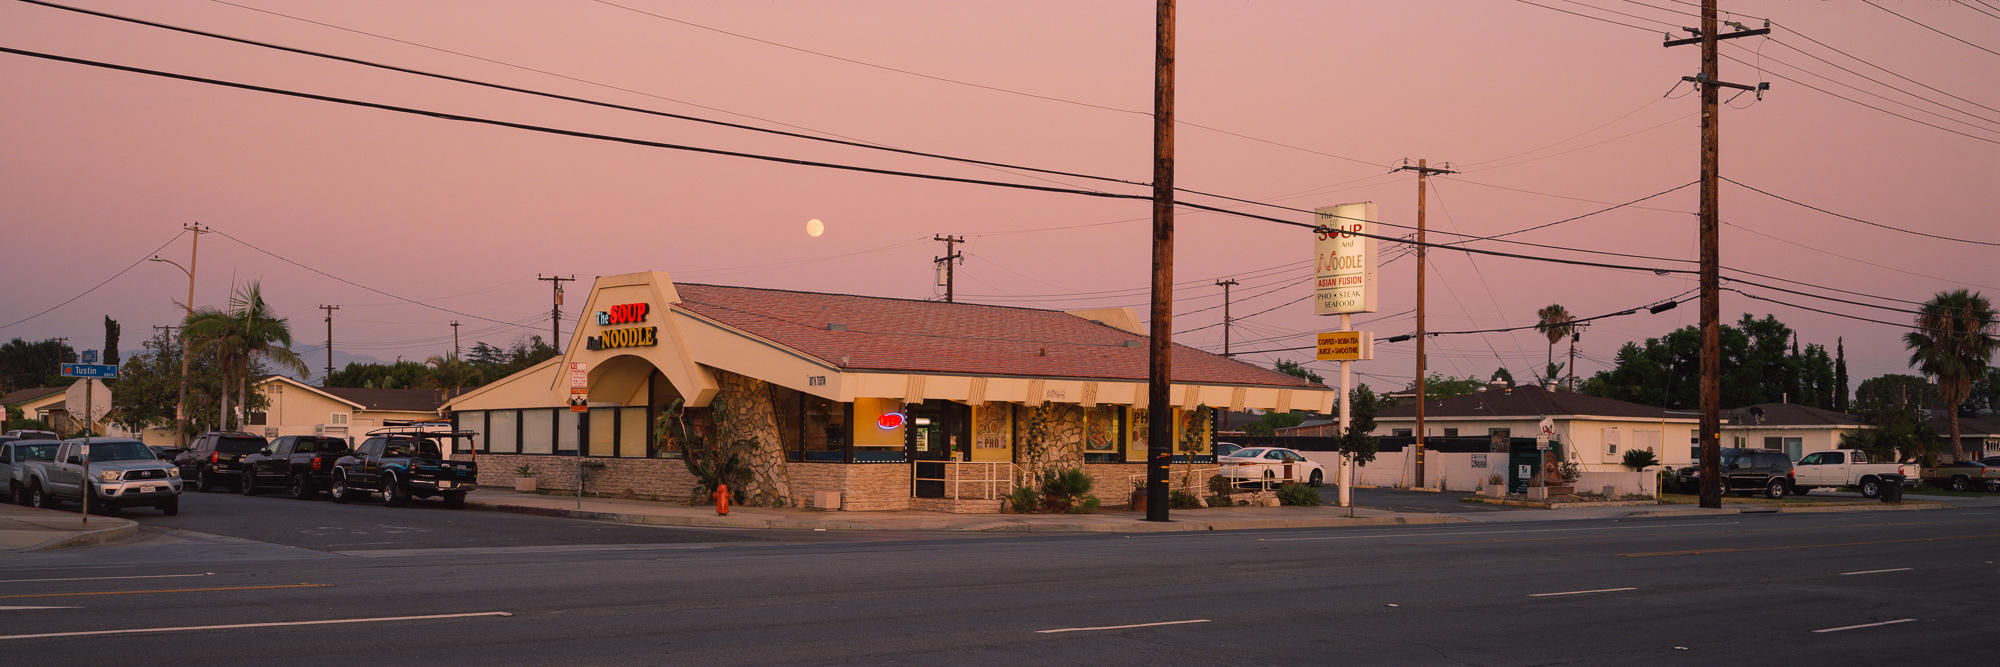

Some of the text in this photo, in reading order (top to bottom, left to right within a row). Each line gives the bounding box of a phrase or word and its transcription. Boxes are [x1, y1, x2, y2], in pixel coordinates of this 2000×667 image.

[1318, 224, 1363, 241] SOUP
[1341, 240, 1354, 248] And
[1317, 251, 1363, 273] NOODLE
[1318, 276, 1362, 287] ASIAN FUSION
[1339, 290, 1361, 298] STEAK
[1325, 300, 1355, 308] SEAFOOD
[596, 302, 648, 325] The SOUP
[586, 326, 655, 350] And NOODLE
[1335, 346, 1358, 354] SMOOTHIE
[75, 366, 97, 375] Tustin
[879, 414, 902, 427] OPEN
[1134, 412, 1149, 424] PH
[985, 438, 999, 448] PHO
